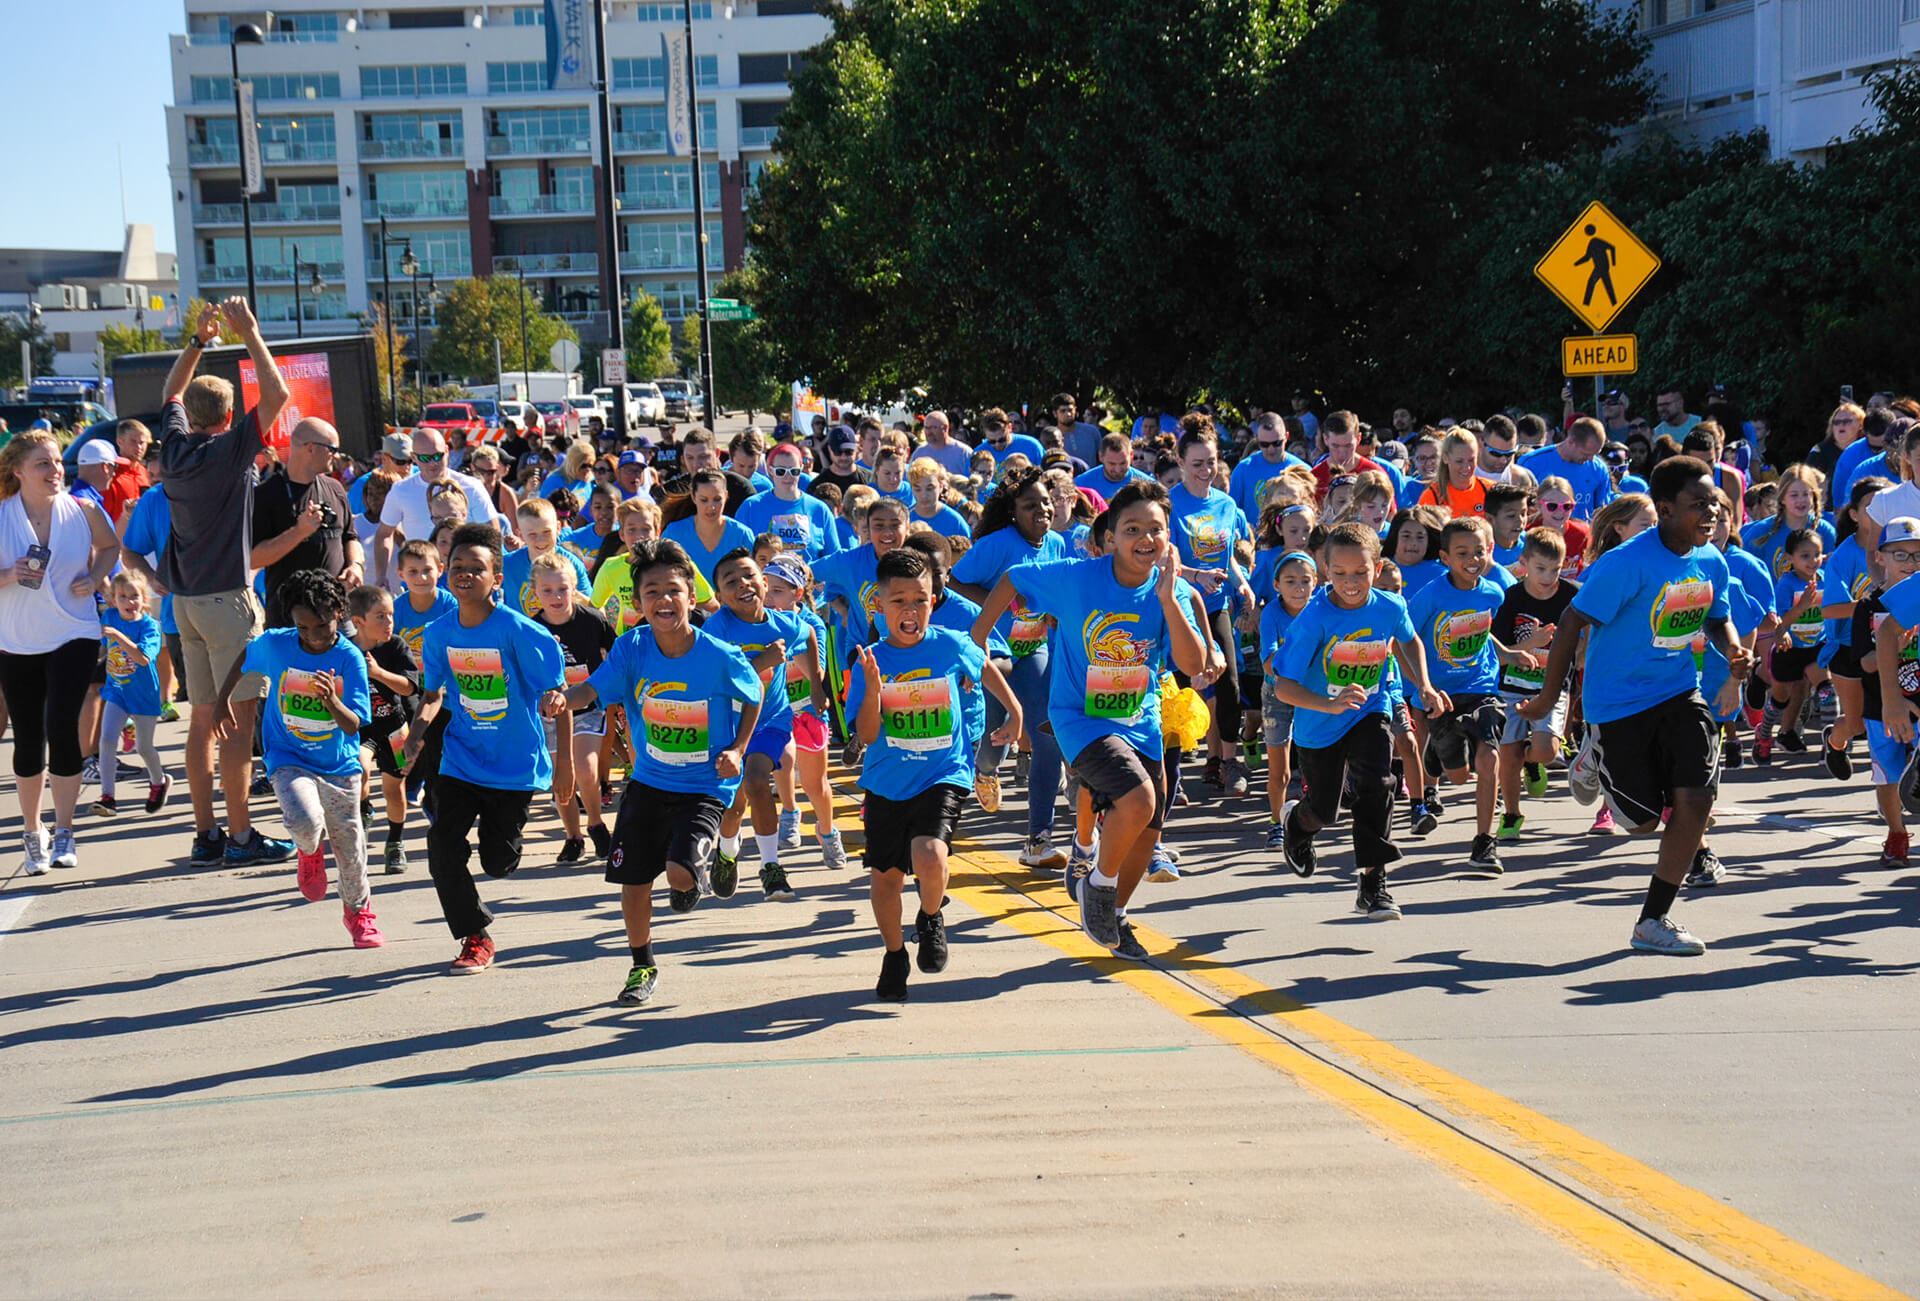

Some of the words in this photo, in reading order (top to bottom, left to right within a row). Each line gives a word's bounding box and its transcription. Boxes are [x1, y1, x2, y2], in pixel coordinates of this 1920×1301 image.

[671, 38, 685, 127] WATERWALK
[602, 359, 625, 367] PARKING
[1572, 346, 1628, 366] AHEAD
[1669, 607, 1704, 630] 6299
[1337, 663, 1379, 681] 6176
[457, 673, 494, 692] 6237
[292, 694, 330, 713] 623
[1094, 691, 1137, 710] 6281
[892, 707, 940, 730] 6111
[650, 723, 698, 745] 6273
